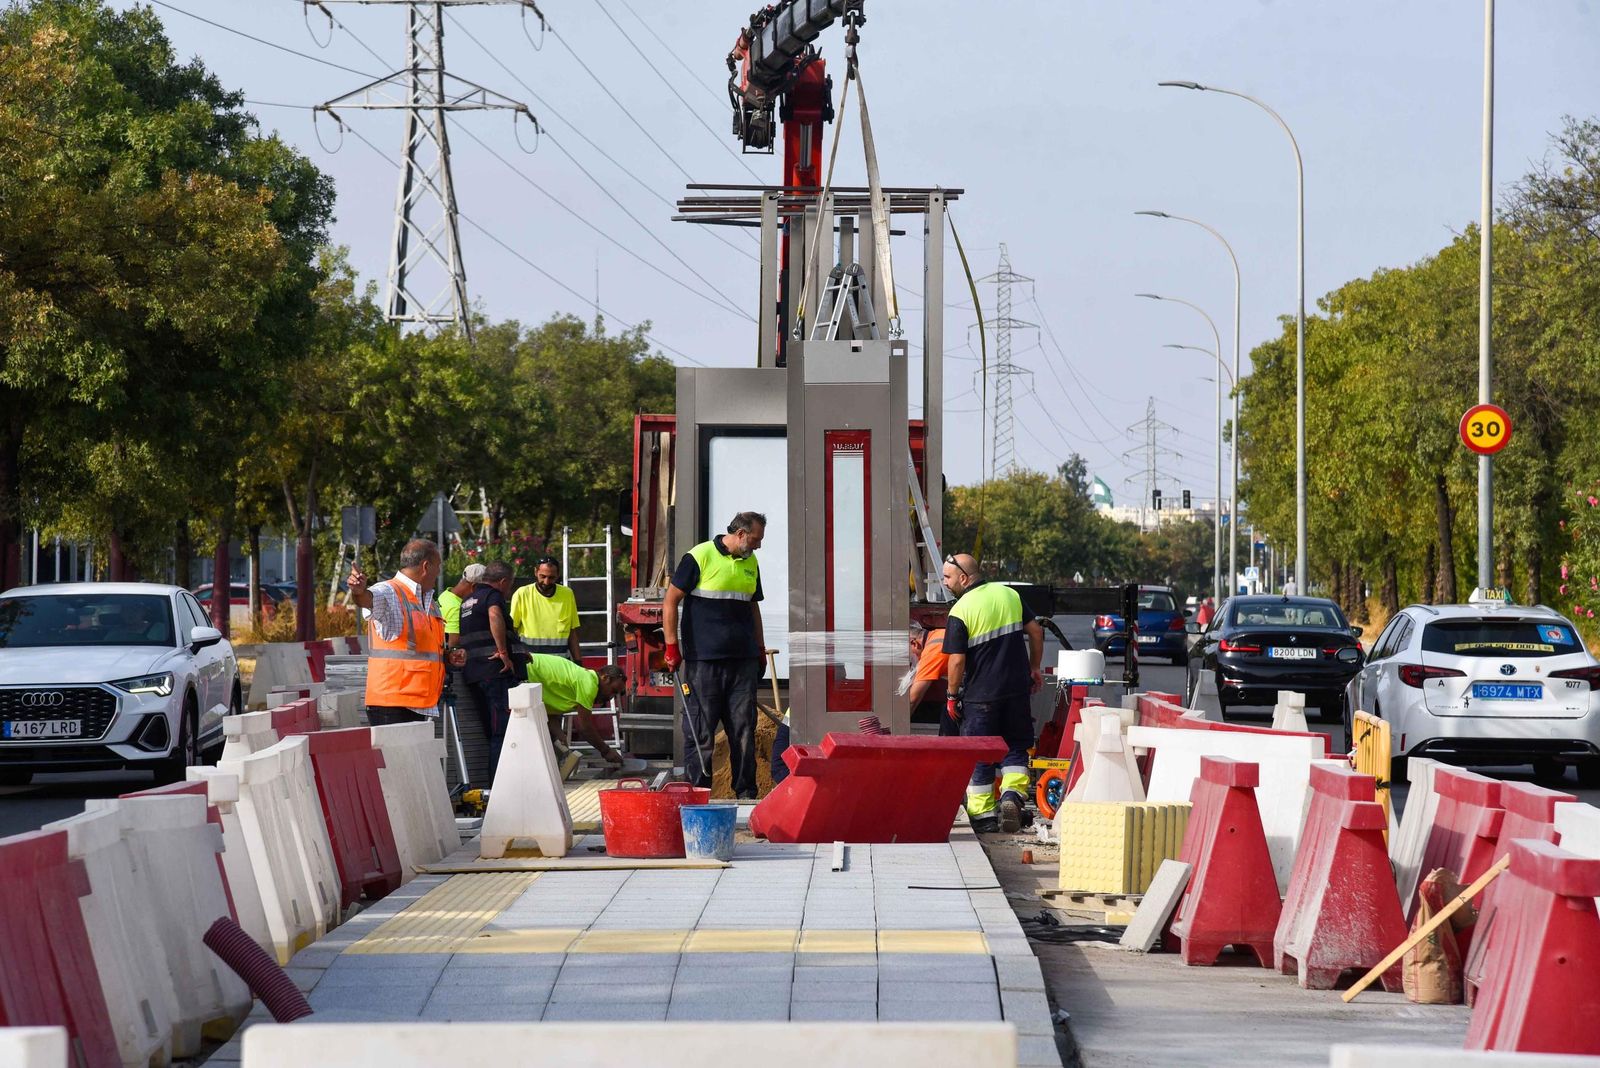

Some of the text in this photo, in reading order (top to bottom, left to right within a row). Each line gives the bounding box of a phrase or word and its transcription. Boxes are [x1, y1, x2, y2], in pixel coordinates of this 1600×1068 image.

[1471, 421, 1500, 438] 30
[1487, 589, 1504, 600] TAXI
[1274, 648, 1314, 657] 8200 LDN
[1438, 679, 1445, 687] A
[1565, 680, 1581, 689] 1077
[1480, 686, 1513, 697] 6974
[13, 721, 77, 735] 4167 LRD
